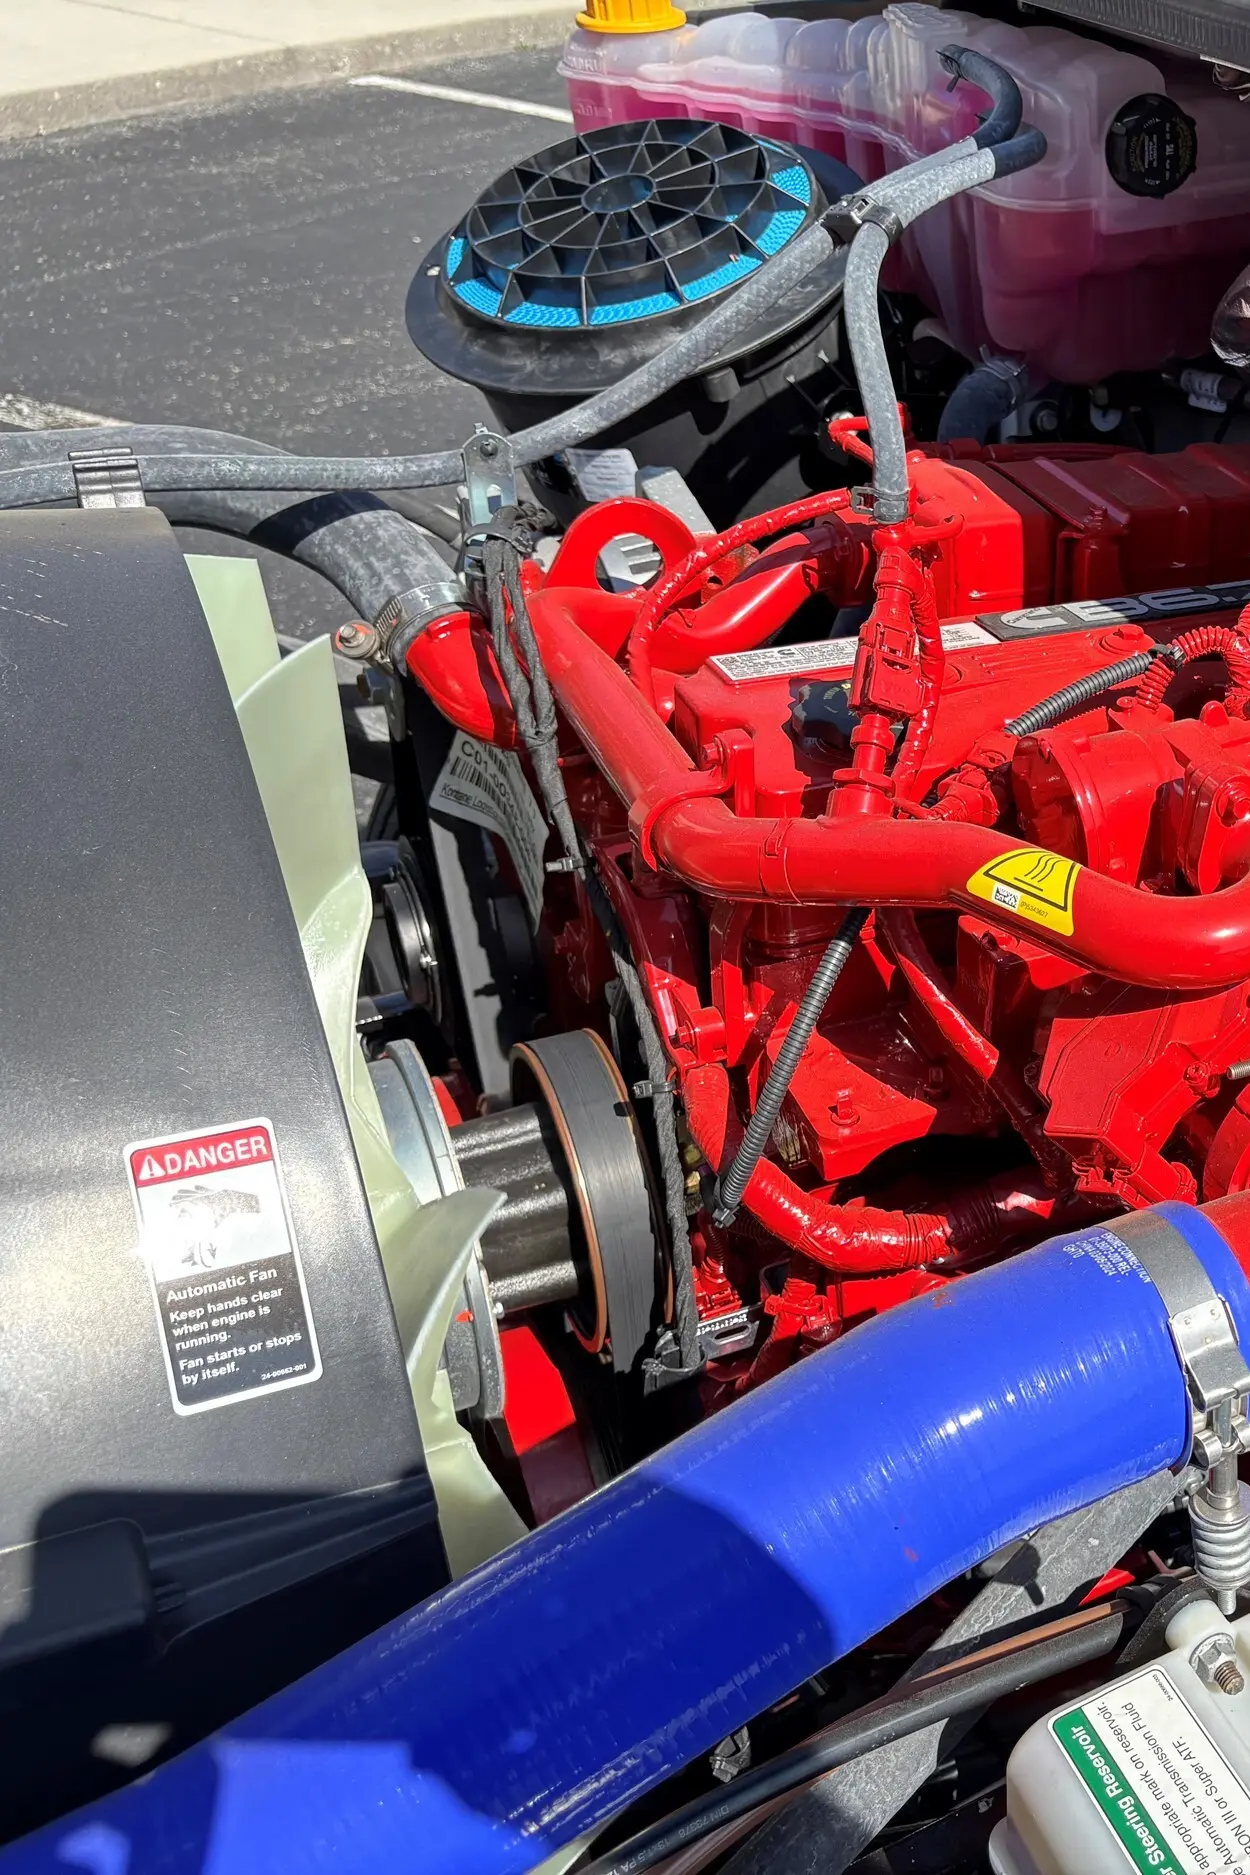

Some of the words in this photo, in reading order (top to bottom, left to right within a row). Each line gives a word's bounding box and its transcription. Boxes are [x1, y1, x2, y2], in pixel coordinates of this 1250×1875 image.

[163, 1135, 267, 1176] DANGER
[164, 1272, 247, 1303] Automatic
[248, 1266, 278, 1283] Fan
[169, 1305, 205, 1323] Keep
[206, 1294, 248, 1314] hands
[250, 1286, 284, 1303] clear
[171, 1319, 209, 1337] when
[210, 1308, 256, 1329] engine
[258, 1304, 271, 1316] is
[174, 1328, 232, 1351] running.
[178, 1355, 205, 1372] Fan
[205, 1344, 246, 1364] starts
[247, 1340, 263, 1353] or
[264, 1331, 303, 1348] stops
[181, 1370, 199, 1385] by
[200, 1360, 239, 1380] itself.
[1092, 1700, 1134, 1753] reservoir.
[1120, 1700, 1147, 1731] Fluid
[1068, 1721, 1124, 1798] Reservoir
[1128, 1752, 1145, 1770] on
[1171, 1735, 1197, 1764] ATF.
[1136, 1769, 1165, 1802] mark
[1139, 1729, 1197, 1807] Transmission
[1187, 1759, 1219, 1798] Super
[708, 1803, 730, 1821] DIN
[1213, 1794, 1228, 1811] or
[1221, 1809, 1237, 1825] III
[1113, 1794, 1167, 1866] Steering
[1157, 1799, 1212, 1871] appropriate
[1189, 1803, 1237, 1867] Automatic
[619, 1857, 637, 1872] PA
